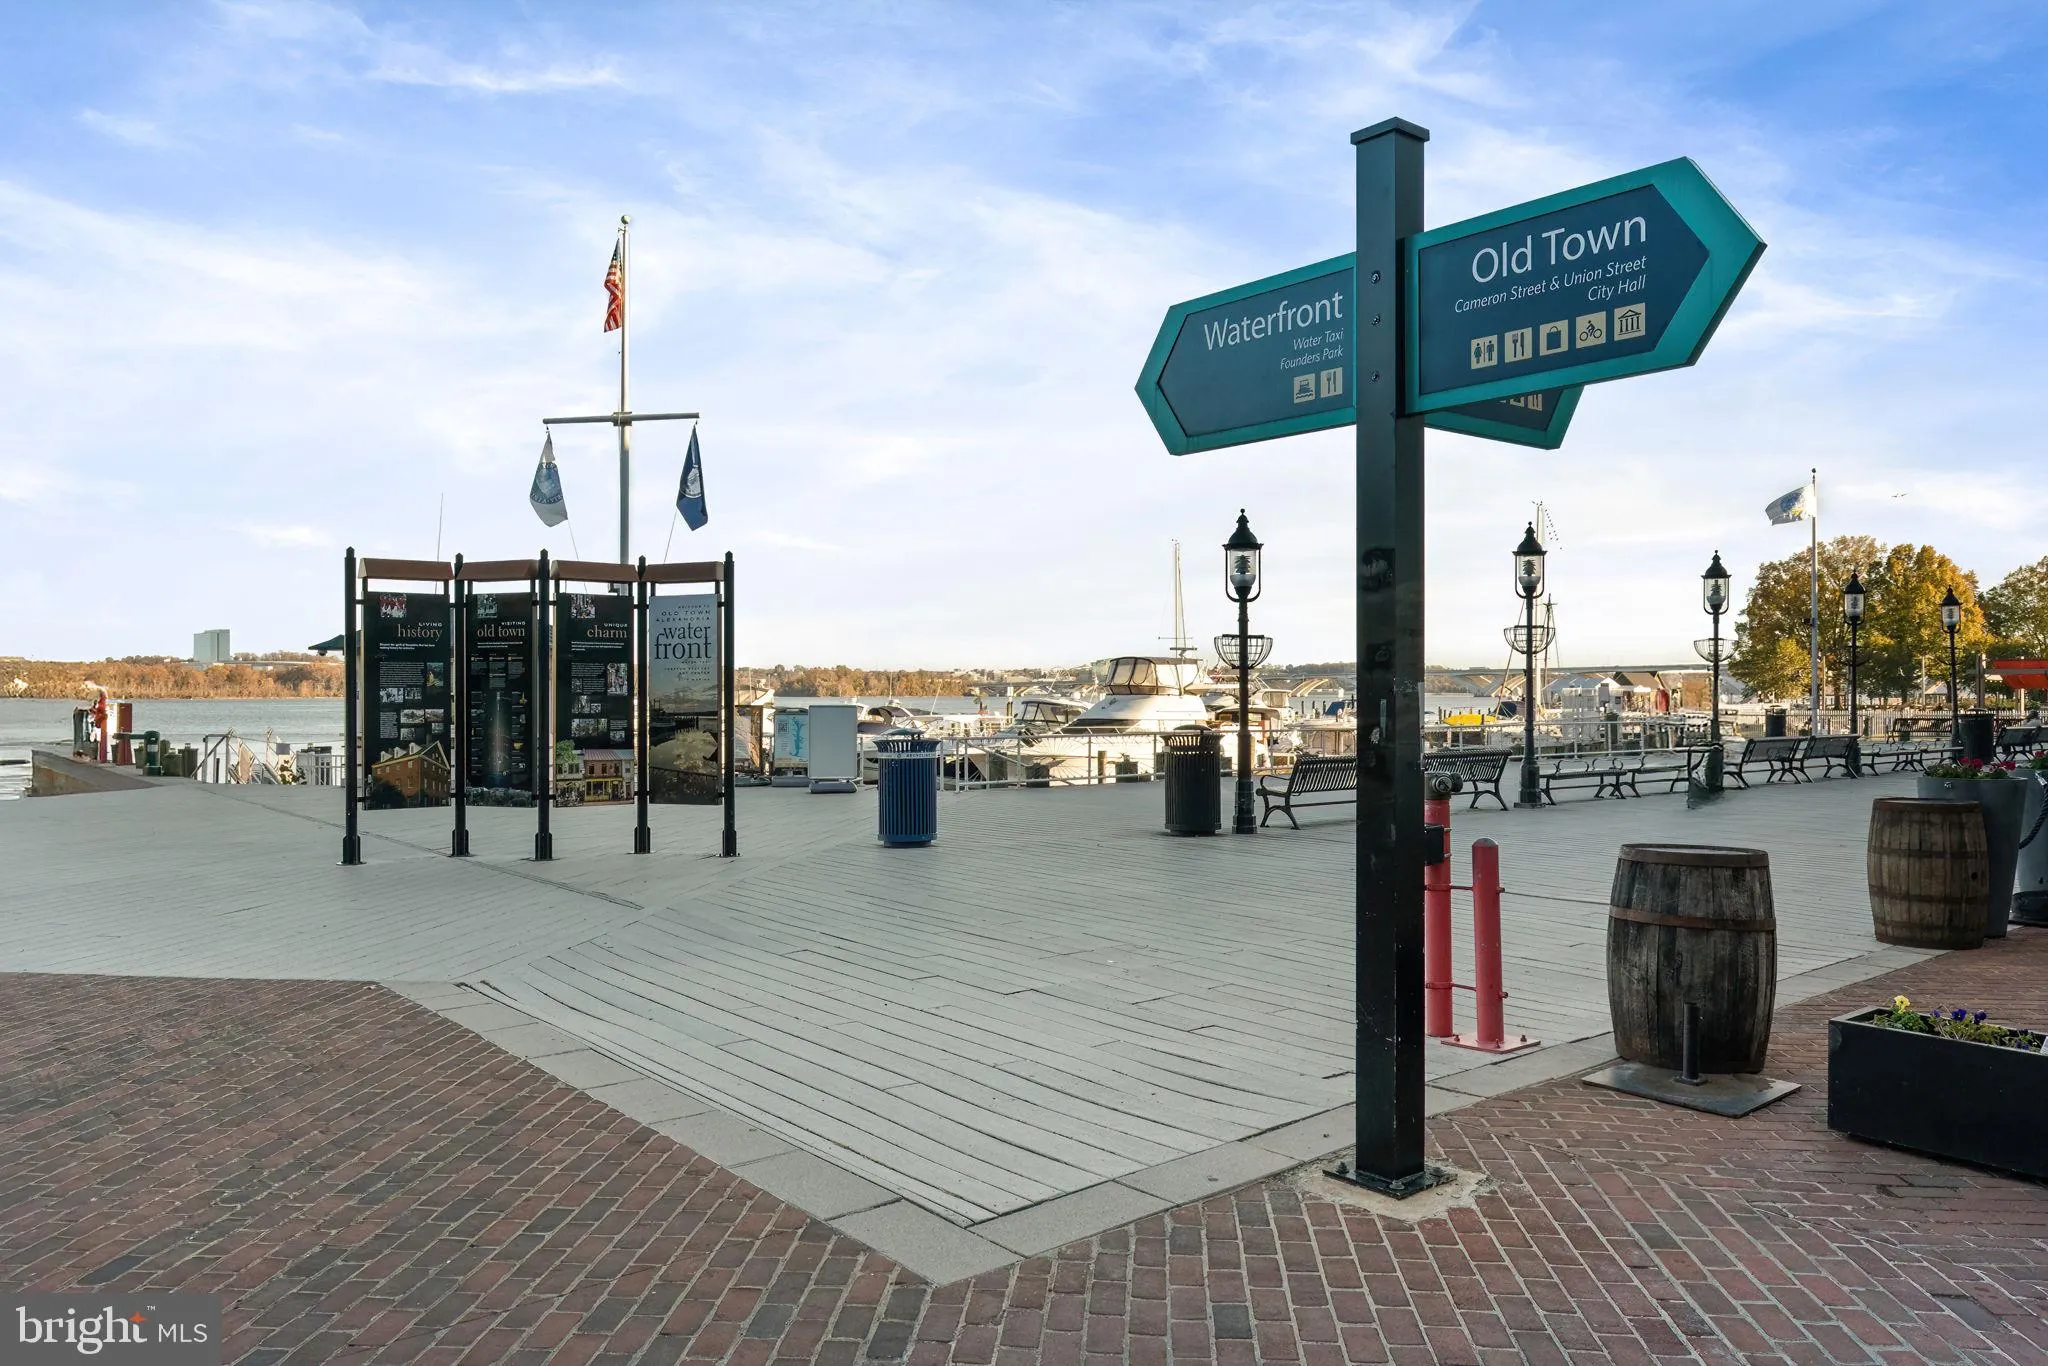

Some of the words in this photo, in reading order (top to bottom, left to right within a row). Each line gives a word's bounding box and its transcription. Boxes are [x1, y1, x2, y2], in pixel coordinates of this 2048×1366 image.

[1472, 234, 1532, 283] Old
[1541, 215, 1646, 265] Town
[1454, 291, 1507, 313] Cameron
[1509, 280, 1546, 300] Street
[1549, 275, 1560, 291] &
[1564, 267, 1602, 287] Union
[1605, 256, 1647, 277] Street
[1588, 285, 1615, 302] City
[1618, 275, 1646, 295] Hall
[1203, 291, 1343, 351] Waterfront
[1293, 334, 1322, 351] Water
[1324, 328, 1344, 344] Taxi
[1280, 352, 1320, 370] Founders
[1322, 346, 1343, 360] Park
[397, 624, 443, 642] history
[477, 624, 495, 637] old
[498, 626, 525, 637] town
[587, 624, 627, 638] charm
[663, 622, 711, 640] water
[654, 632, 712, 660] front
